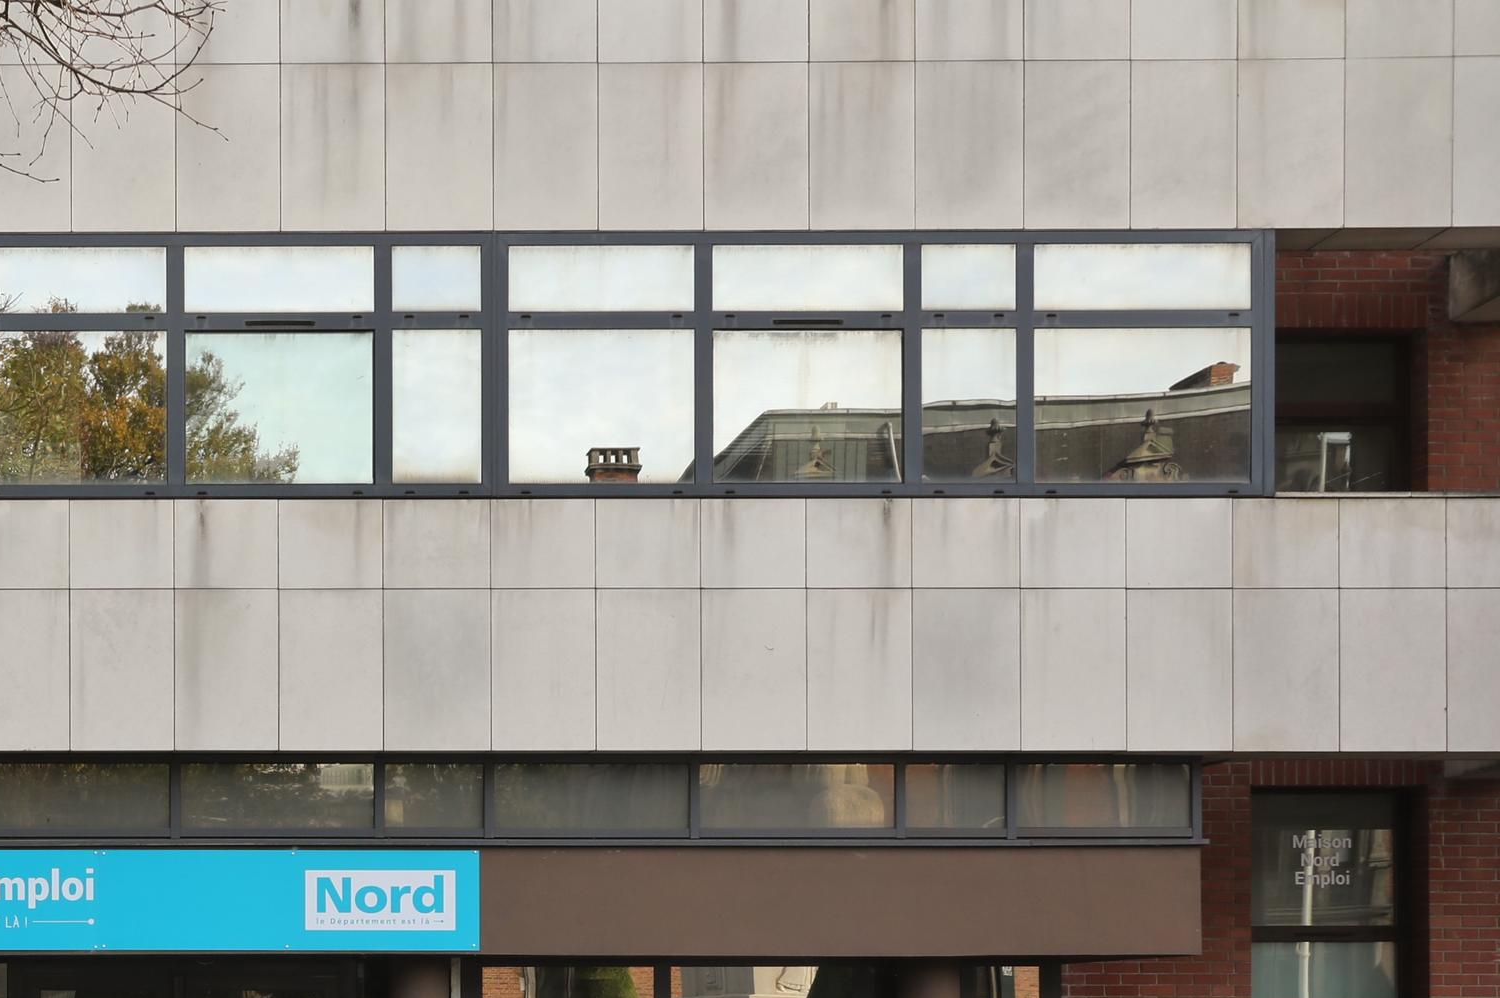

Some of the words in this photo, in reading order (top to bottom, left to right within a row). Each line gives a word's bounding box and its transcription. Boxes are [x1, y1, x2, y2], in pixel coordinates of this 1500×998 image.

[1292, 833, 1352, 849] Maison
[1300, 852, 1340, 867] Nord
[1295, 870, 1350, 888] Emploi
[316, 874, 444, 913] Nord
[5, 914, 20, 928] LÀ
